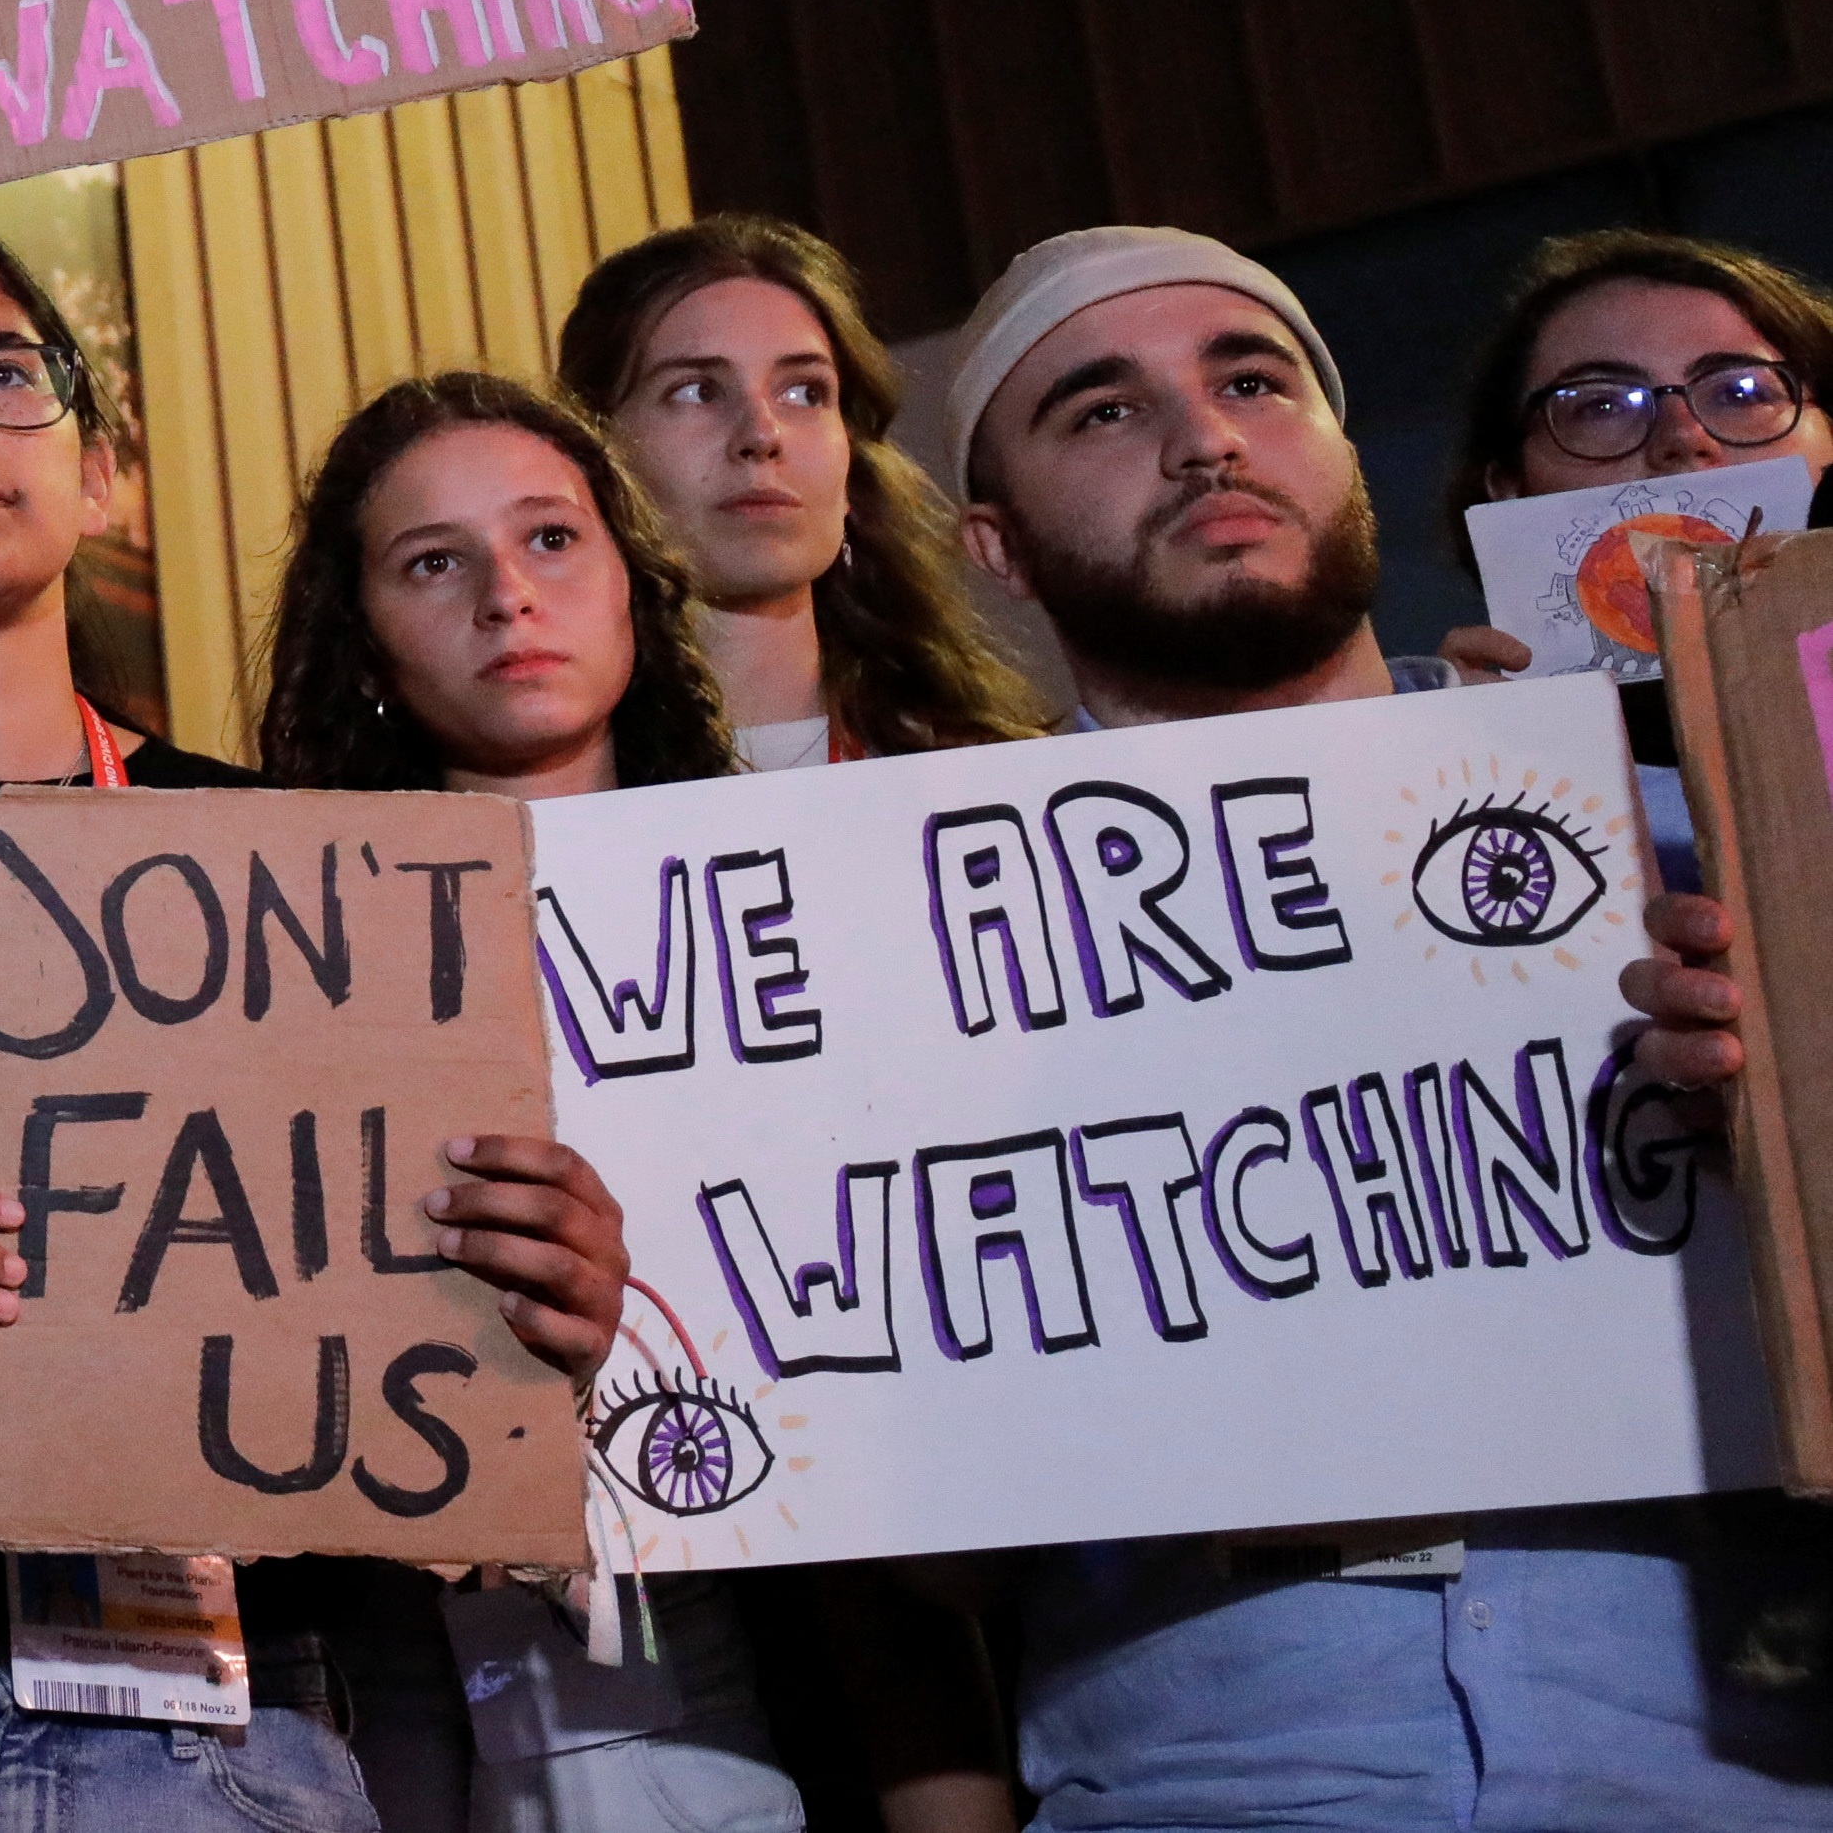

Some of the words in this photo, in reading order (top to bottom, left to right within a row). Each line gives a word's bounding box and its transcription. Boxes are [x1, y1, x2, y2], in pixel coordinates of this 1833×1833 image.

[98, 734, 115, 766] CIVIC
[105, 766, 119, 789] AND
[536, 850, 823, 1084] WE
[924, 776, 1352, 1036] ARE
[17, 1092, 461, 1314] FAIL
[698, 1036, 1699, 1380] WATCHING
[1393, 1553, 1416, 1563] Nov
[1419, 1552, 1433, 1562] 22
[137, 1613, 216, 1633] OBSERVER
[62, 1633, 111, 1650] Patricia
[114, 1640, 206, 1658] Islam-Parsons
[163, 1699, 177, 1710] 06
[186, 1701, 197, 1712] 18
[200, 1703, 221, 1715] Nov
[224, 1704, 237, 1715] 22
